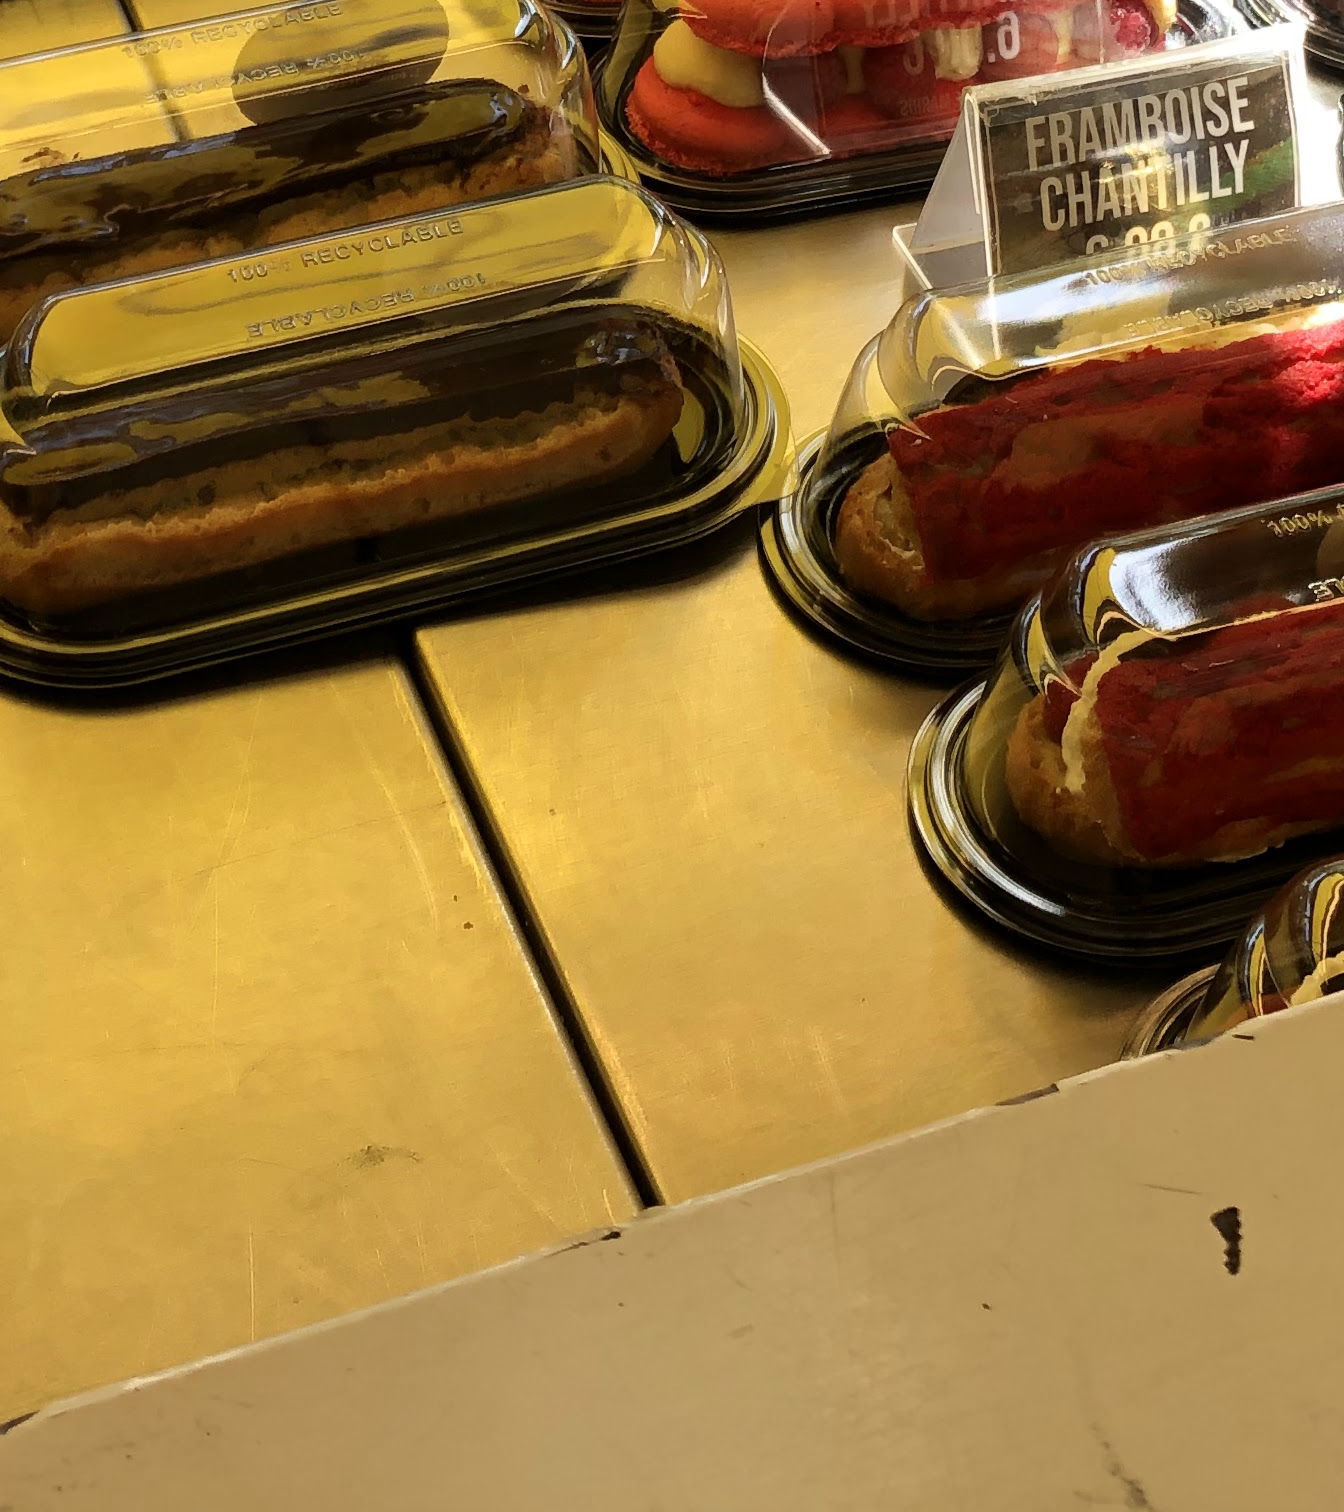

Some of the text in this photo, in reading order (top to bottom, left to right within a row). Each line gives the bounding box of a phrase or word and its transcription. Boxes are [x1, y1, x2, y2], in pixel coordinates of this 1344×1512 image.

[190, 4, 342, 45] RECYCLABLE
[1025, 76, 1255, 172] FRAMBOISE
[1039, 139, 1252, 232] CHANTILLY
[301, 219, 464, 269] RECYCLABLE
[246, 288, 415, 339] RECYCLABLE
[1264, 510, 1333, 538] 100%
